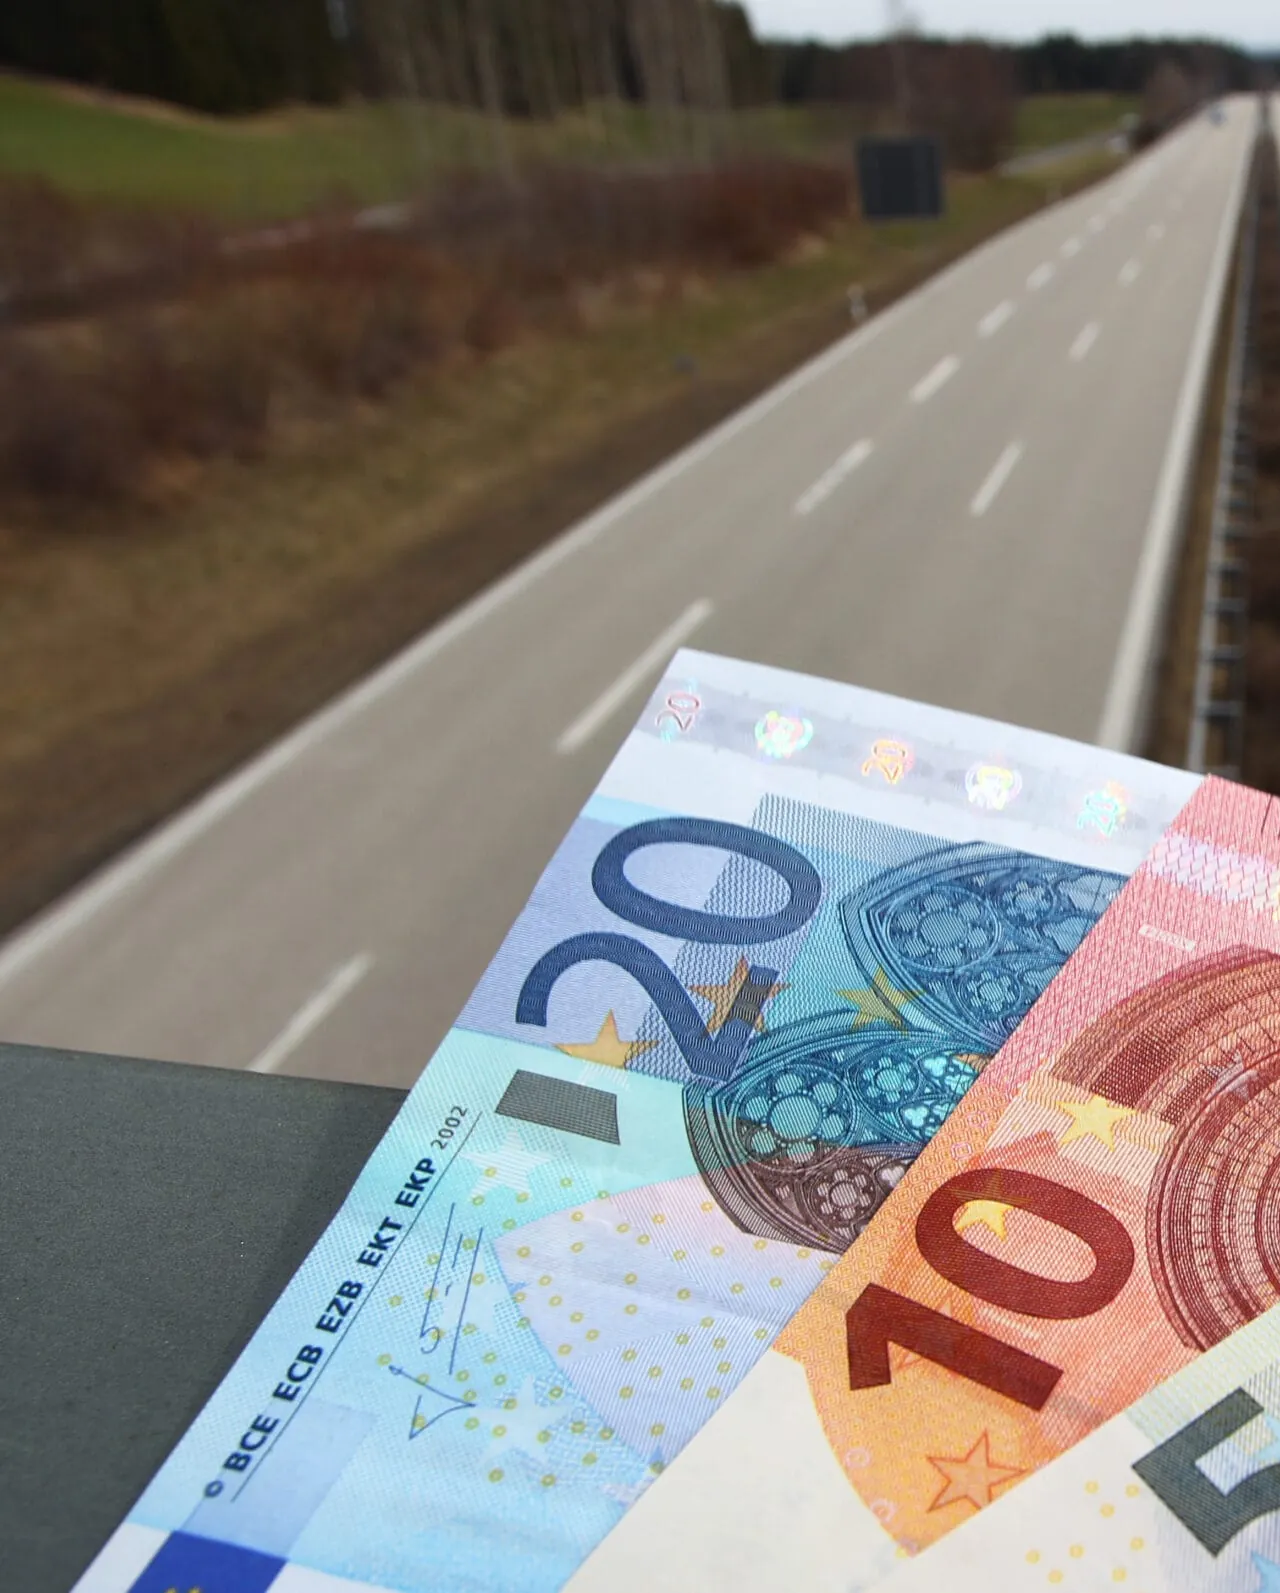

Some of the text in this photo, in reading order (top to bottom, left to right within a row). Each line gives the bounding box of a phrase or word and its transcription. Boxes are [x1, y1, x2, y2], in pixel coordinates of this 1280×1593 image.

[655, 691, 701, 733] 20
[515, 816, 822, 1082] 20
[222, 1413, 281, 1473] BCE
[272, 1343, 324, 1402] ECB
[314, 1279, 364, 1334] EZB
[355, 1215, 403, 1268] EKT
[394, 1156, 437, 1208] EKP
[430, 1104, 469, 1151] 2002
[845, 1167, 1135, 1412] 10
